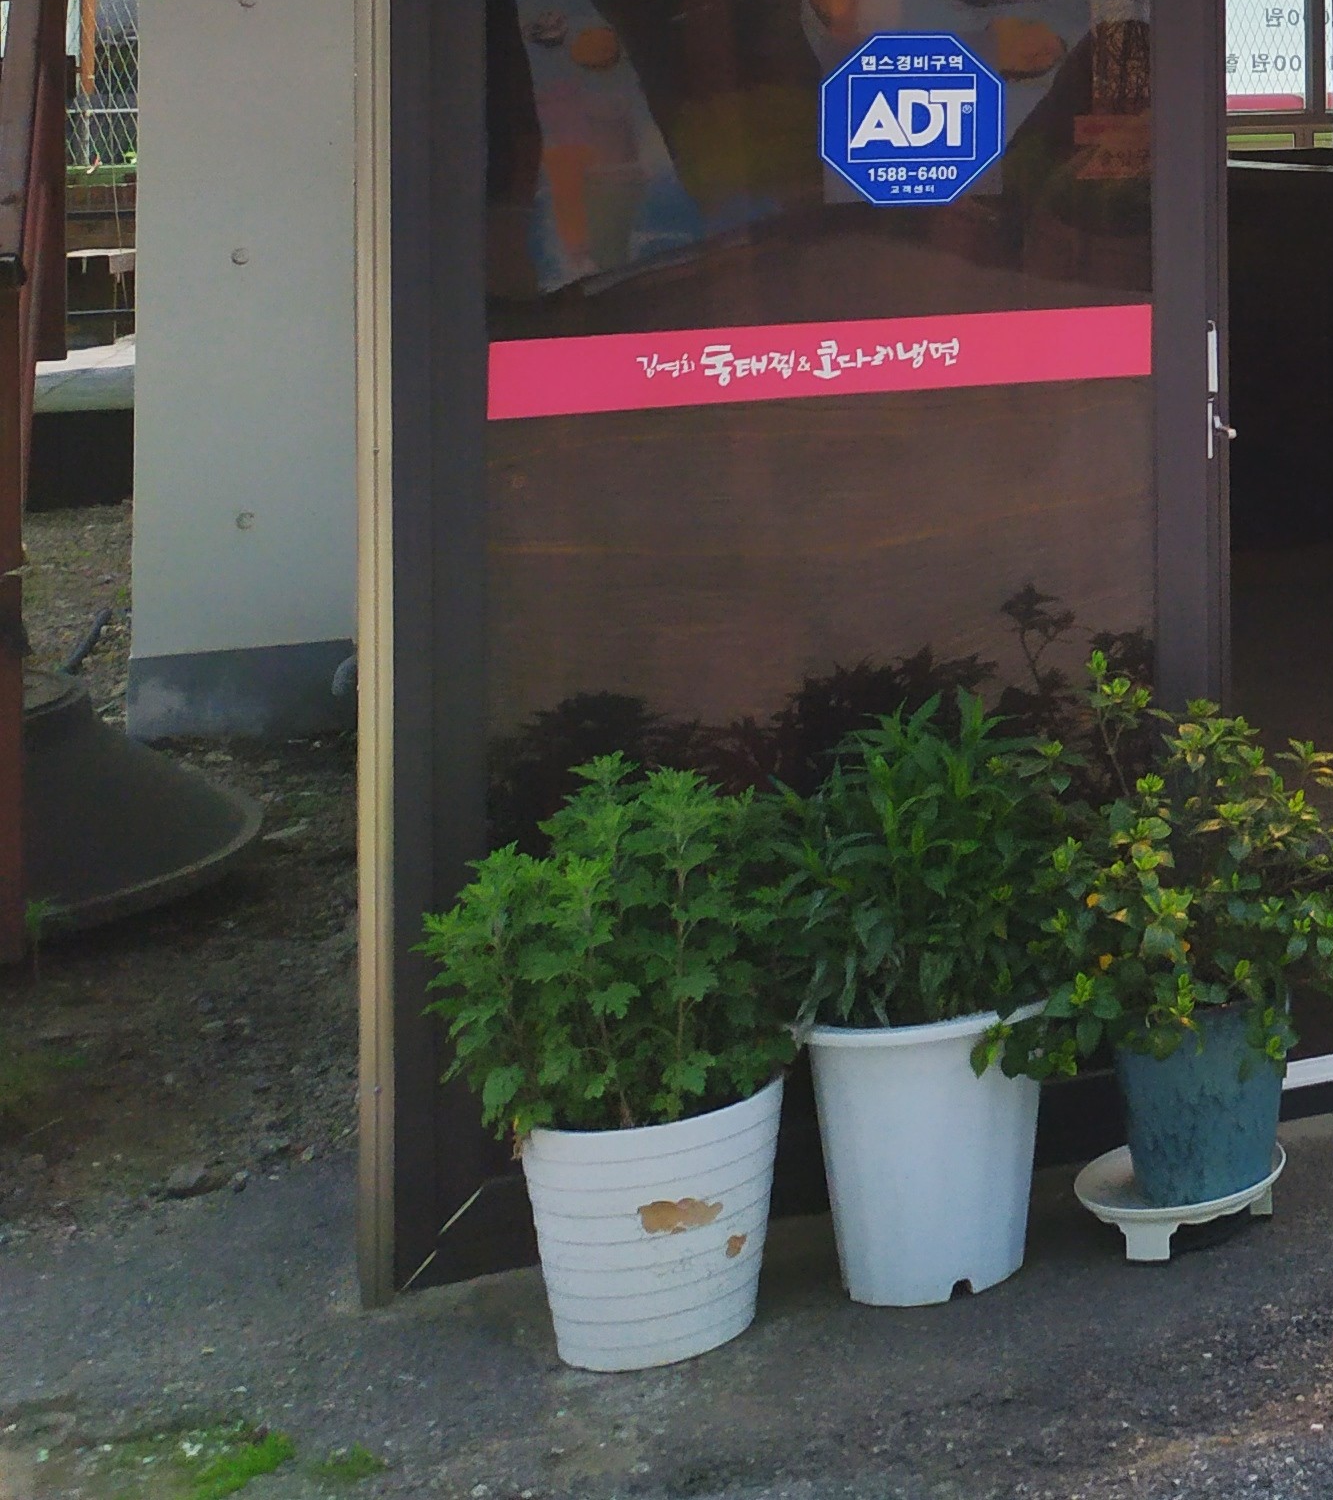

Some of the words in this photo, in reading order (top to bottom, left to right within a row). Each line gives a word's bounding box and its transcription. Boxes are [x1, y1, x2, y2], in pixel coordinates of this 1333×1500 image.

[861, 55, 963, 72] 캡스경비구역
[850, 88, 976, 149] ADT
[868, 165, 958, 182] 1588-6400
[636, 352, 696, 378] 김영희
